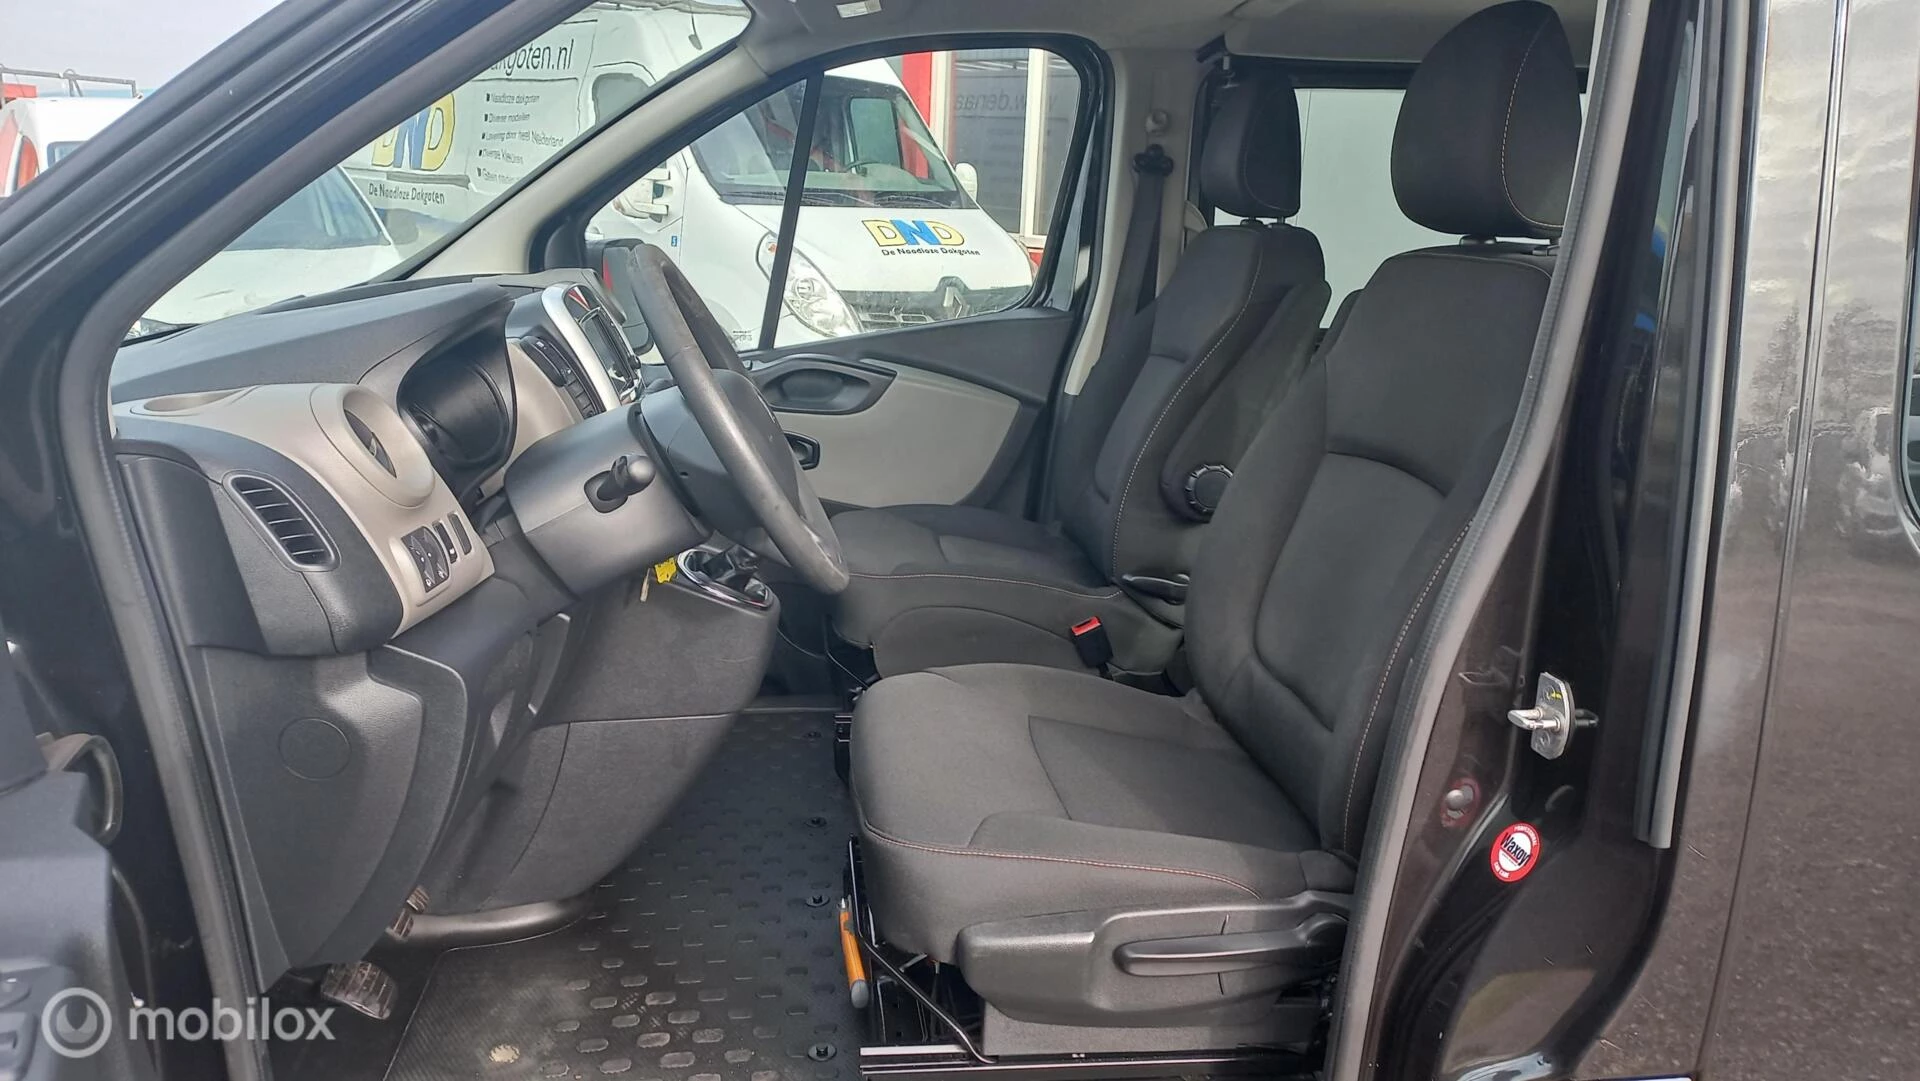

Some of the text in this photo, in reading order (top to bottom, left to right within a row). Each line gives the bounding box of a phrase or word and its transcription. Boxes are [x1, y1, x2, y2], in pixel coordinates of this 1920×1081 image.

[490, 38, 575, 77] goten.nl
[369, 183, 378, 196] De
[411, 187, 446, 206] Dakgoten
[861, 219, 965, 247] DND
[940, 247, 981, 256] Dakgoten
